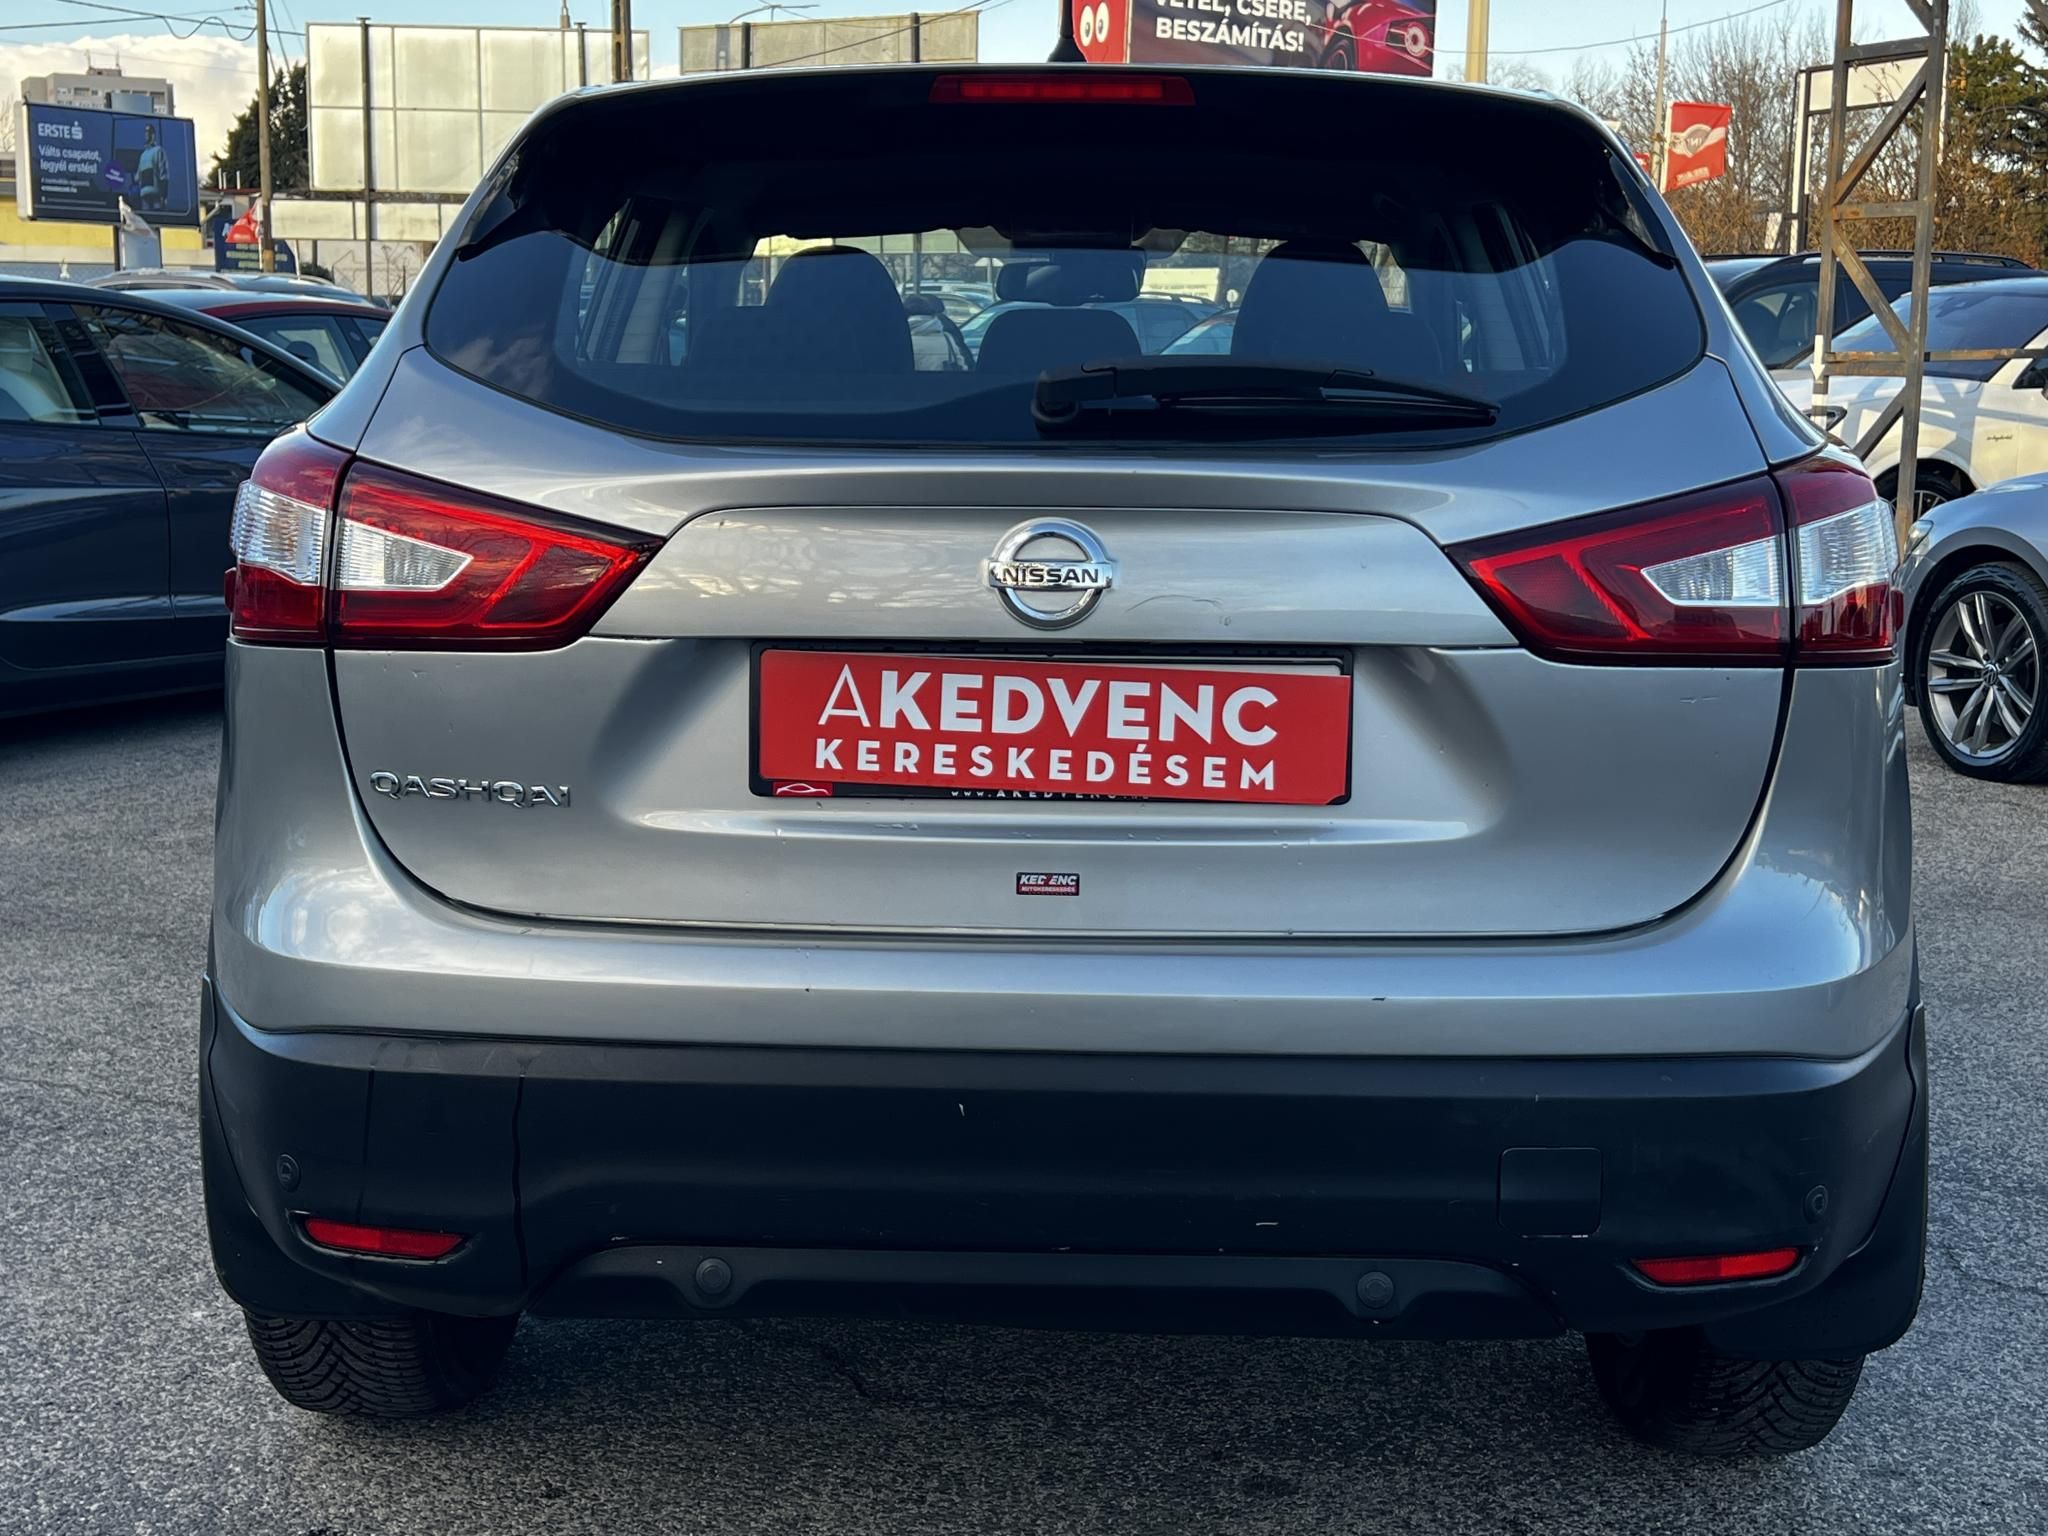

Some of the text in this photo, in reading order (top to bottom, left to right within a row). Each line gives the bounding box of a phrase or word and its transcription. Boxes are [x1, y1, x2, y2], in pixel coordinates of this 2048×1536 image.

[1156, 0, 1312, 26] EL, CSERE,
[1155, 16, 1305, 52] BESZÁMÍTÁS!
[38, 123, 71, 139] ERSTE
[1002, 568, 1099, 584] NISSAN
[814, 738, 1276, 791] KERESKEDÉSEM
[370, 770, 571, 809] QASHQAI
[950, 789, 1149, 799] www.AKED.
[1019, 874, 1077, 885] KEDENC
